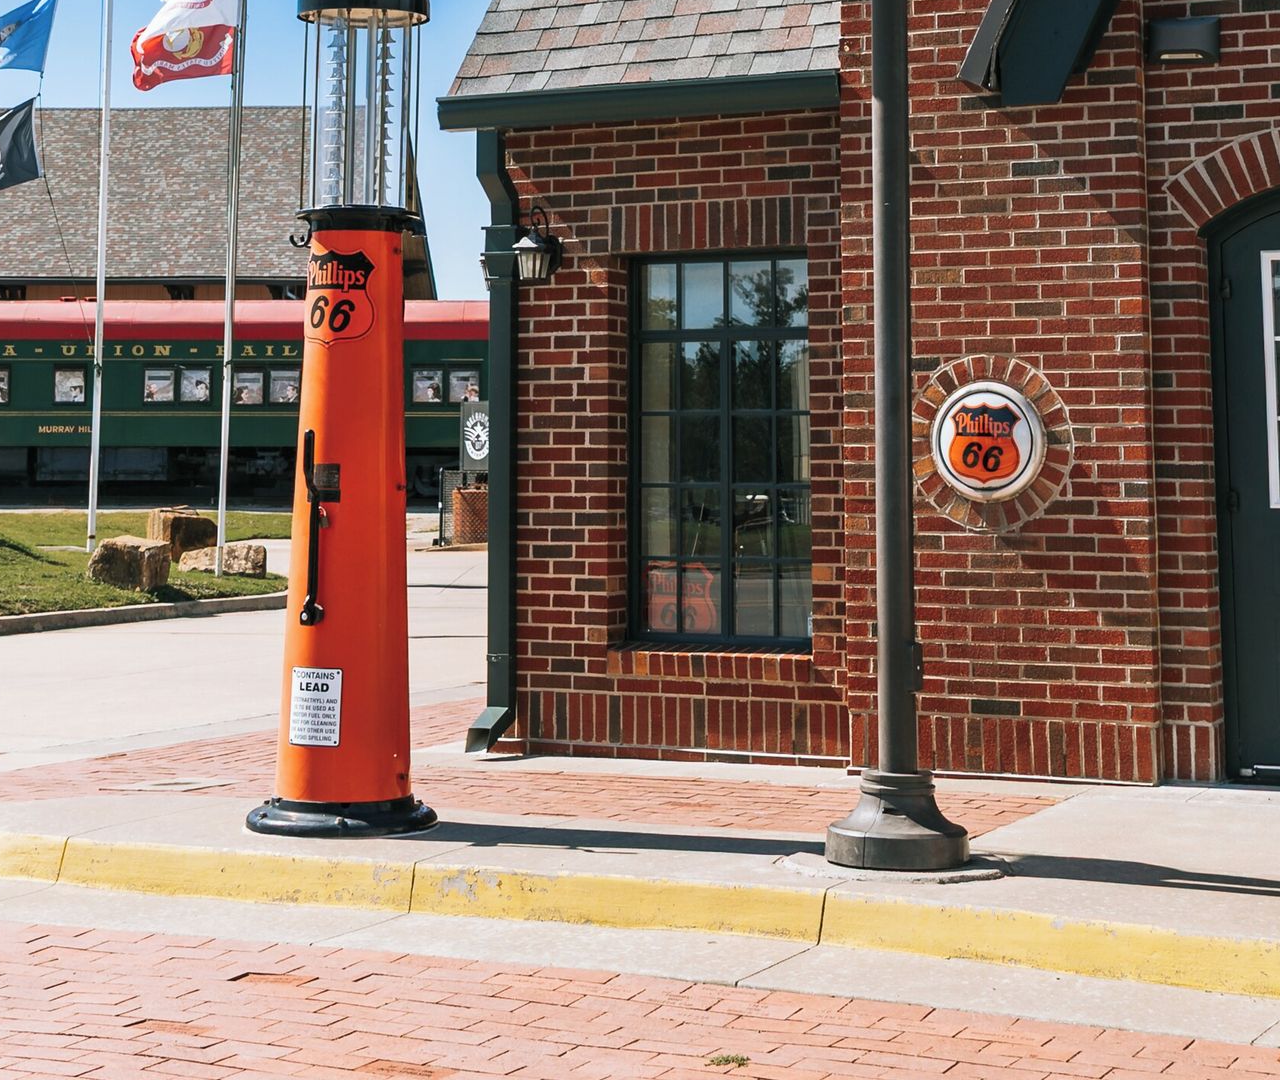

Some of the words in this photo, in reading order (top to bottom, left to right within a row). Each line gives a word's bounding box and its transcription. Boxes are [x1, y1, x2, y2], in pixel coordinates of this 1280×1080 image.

[309, 260, 365, 292] Phillips
[311, 295, 356, 333] 66
[38, 425, 75, 433] MURRAY
[78, 425, 93, 433] HIL
[955, 412, 1010, 439] Phillips
[962, 442, 1003, 472] 66
[296, 671, 335, 680] CONTAINS
[299, 682, 330, 692] LEAD
